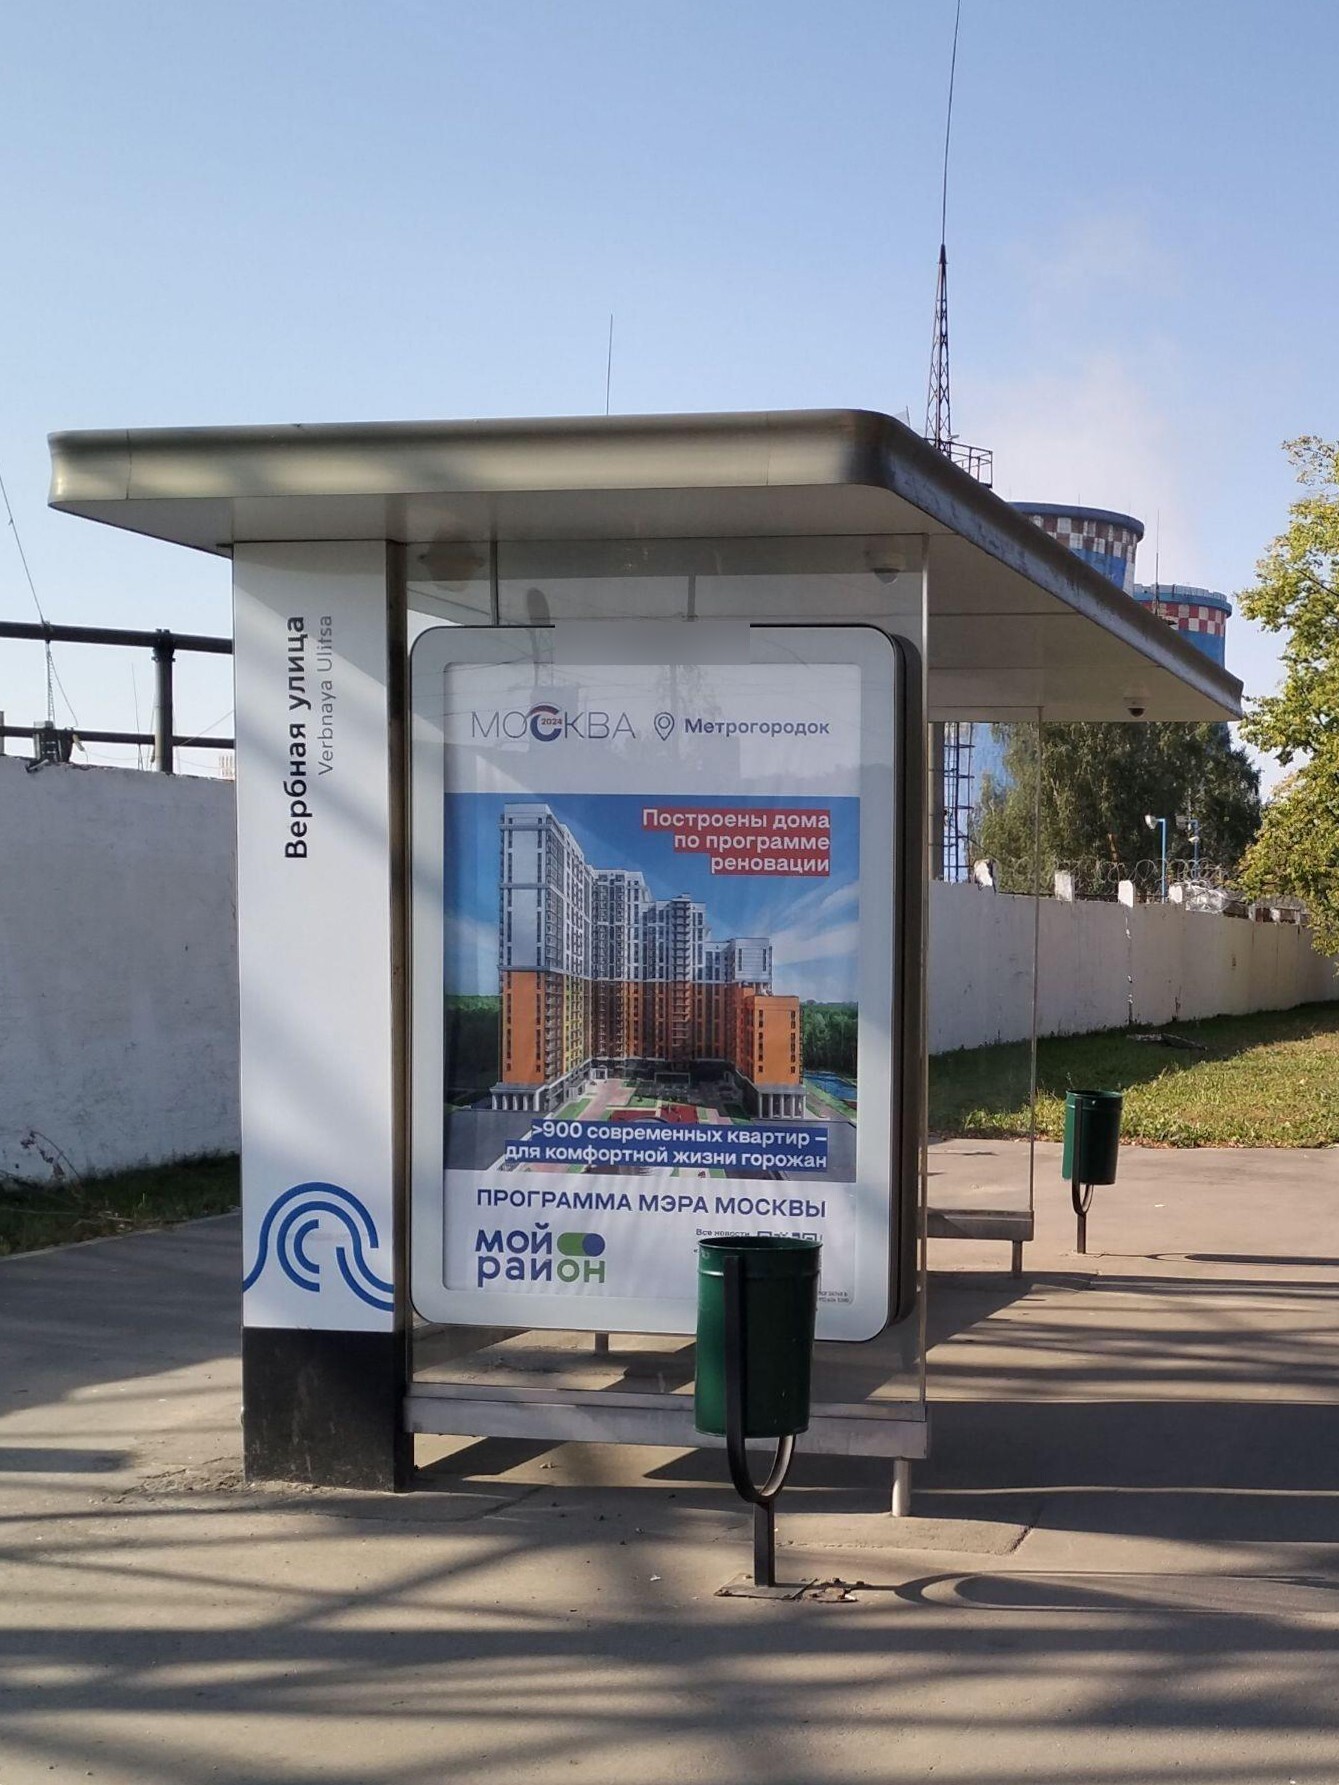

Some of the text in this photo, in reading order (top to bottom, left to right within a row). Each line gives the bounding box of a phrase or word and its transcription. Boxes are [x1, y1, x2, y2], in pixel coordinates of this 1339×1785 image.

[317, 615, 336, 775] Verbnaya Ulitsa
[471, 702, 636, 742] МОСКВА
[541, 717, 563, 726] 2024
[685, 718, 830, 737] Метрогородок
[283, 616, 312, 859] Вербная улица
[643, 809, 831, 831] Построены дома
[674, 835, 831, 853] по программе
[711, 857, 829, 874] реновации
[532, 1121, 582, 1138] >900
[587, 1125, 723, 1144] современных
[727, 1130, 810, 1148] квартир
[505, 1145, 827, 1170] для комфортной жизни горожан
[477, 1189, 826, 1217] ПРОГРАММА МЭРА МОСКВЫ
[475, 1222, 552, 1254] мой
[696, 1228, 713, 1237] Все
